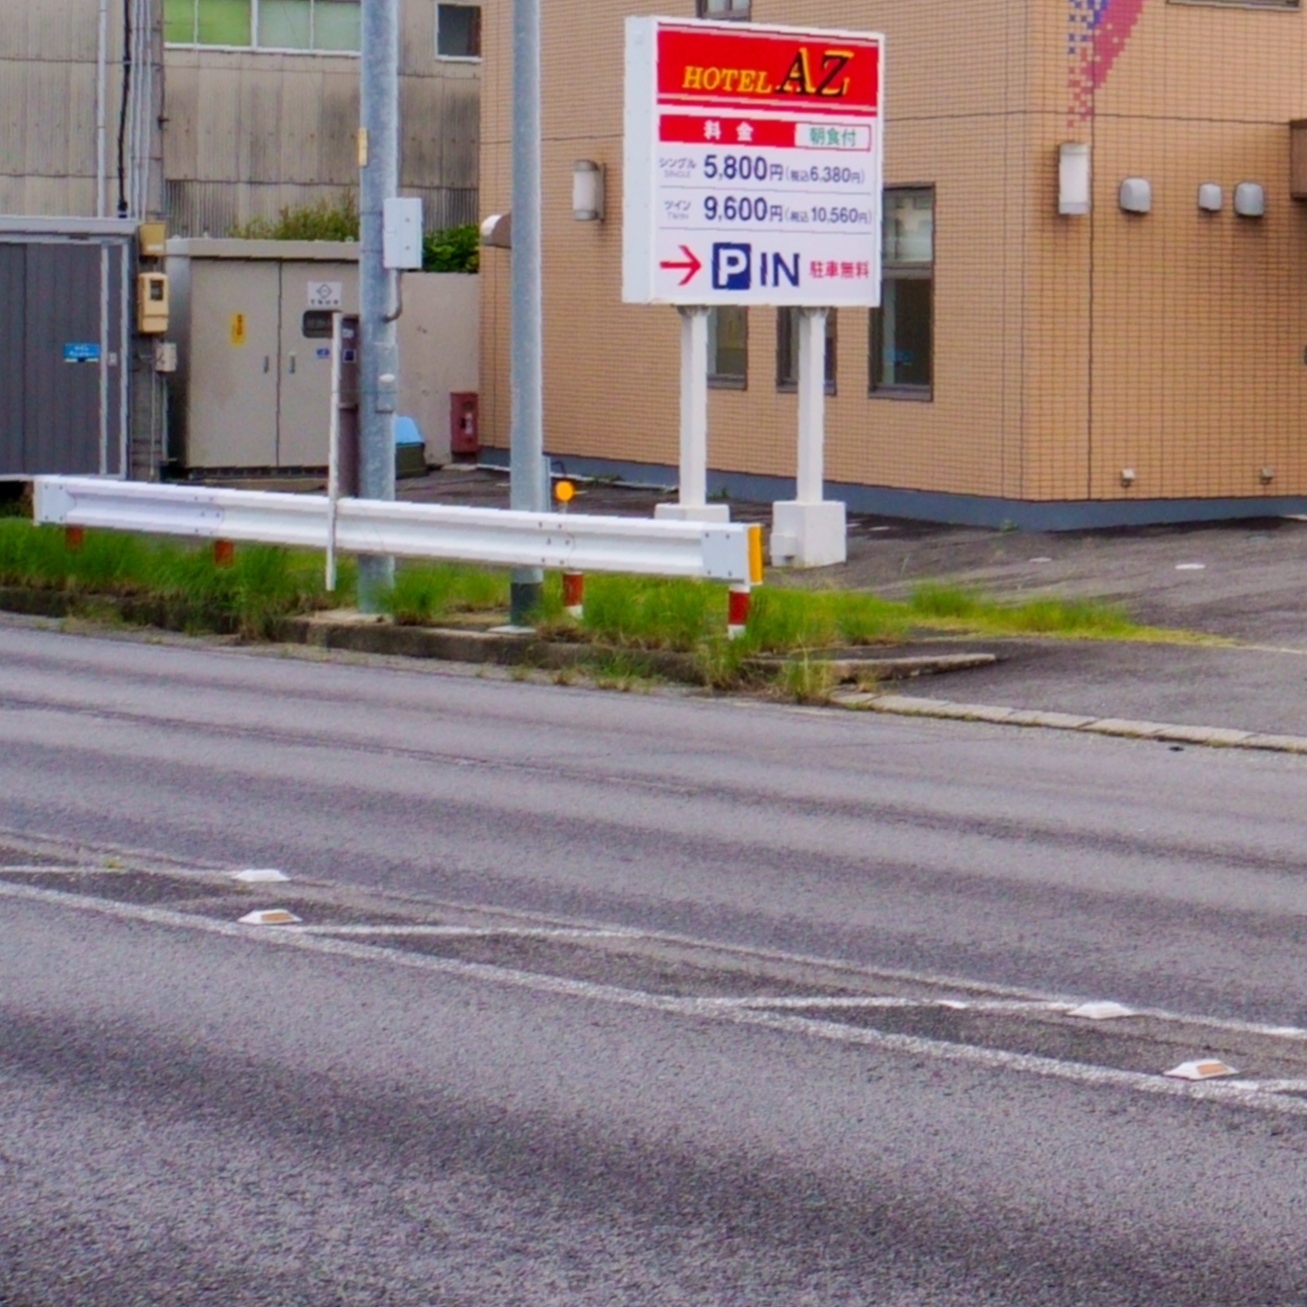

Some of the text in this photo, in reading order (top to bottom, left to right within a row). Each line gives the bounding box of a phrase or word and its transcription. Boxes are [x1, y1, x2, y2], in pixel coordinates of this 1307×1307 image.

[682, 47, 854, 97] HOTEL AZ
[809, 127, 857, 147] 朝食付
[659, 157, 697, 170] シングル
[664, 199, 692, 210] ツイン
[718, 248, 801, 288] P IN
[809, 260, 869, 280] 駐車無料
